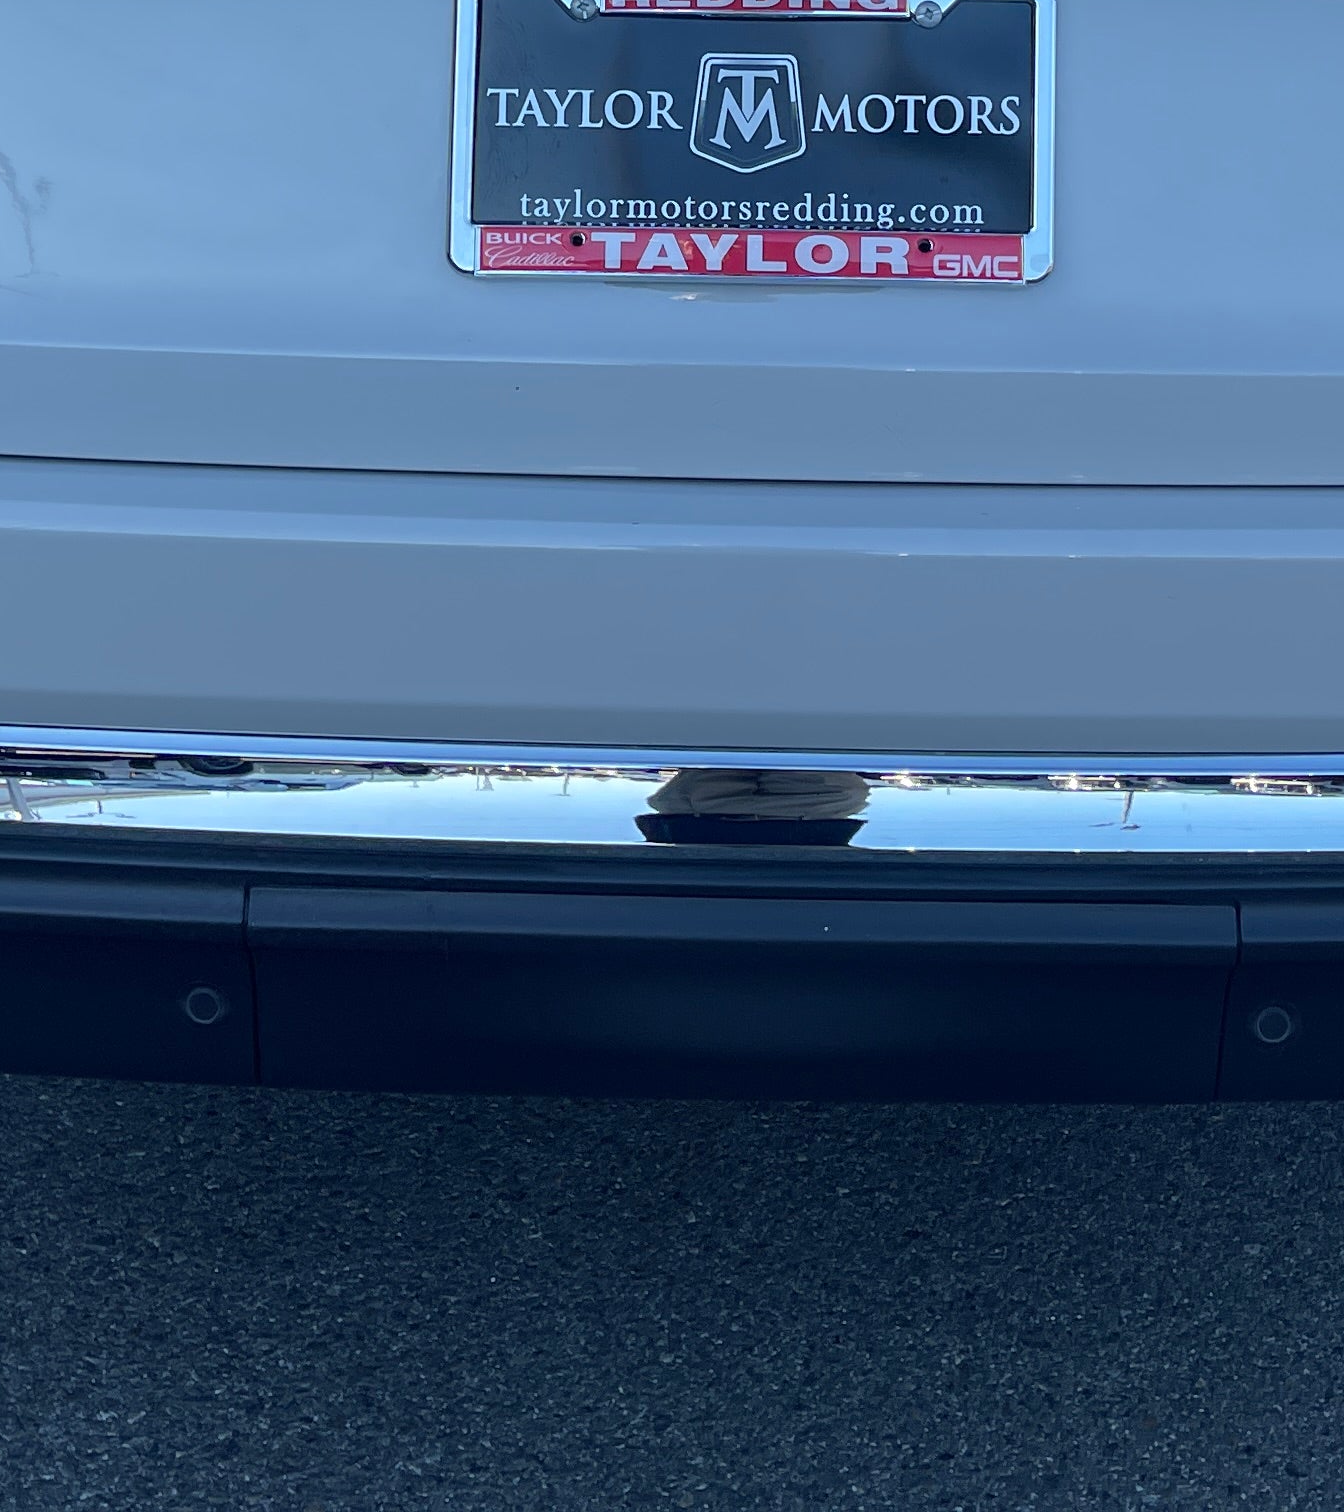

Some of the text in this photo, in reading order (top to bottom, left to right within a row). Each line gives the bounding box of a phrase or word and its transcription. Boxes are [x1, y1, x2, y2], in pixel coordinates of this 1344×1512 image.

[487, 88, 683, 130] TAYLOR
[811, 93, 1021, 136] MOTORS
[519, 189, 985, 229] taylormotorsredding.com
[486, 232, 562, 245] BUICK
[590, 232, 910, 274] TAYLOR
[484, 245, 575, 268] Cadillac
[932, 254, 1019, 279] GMC
